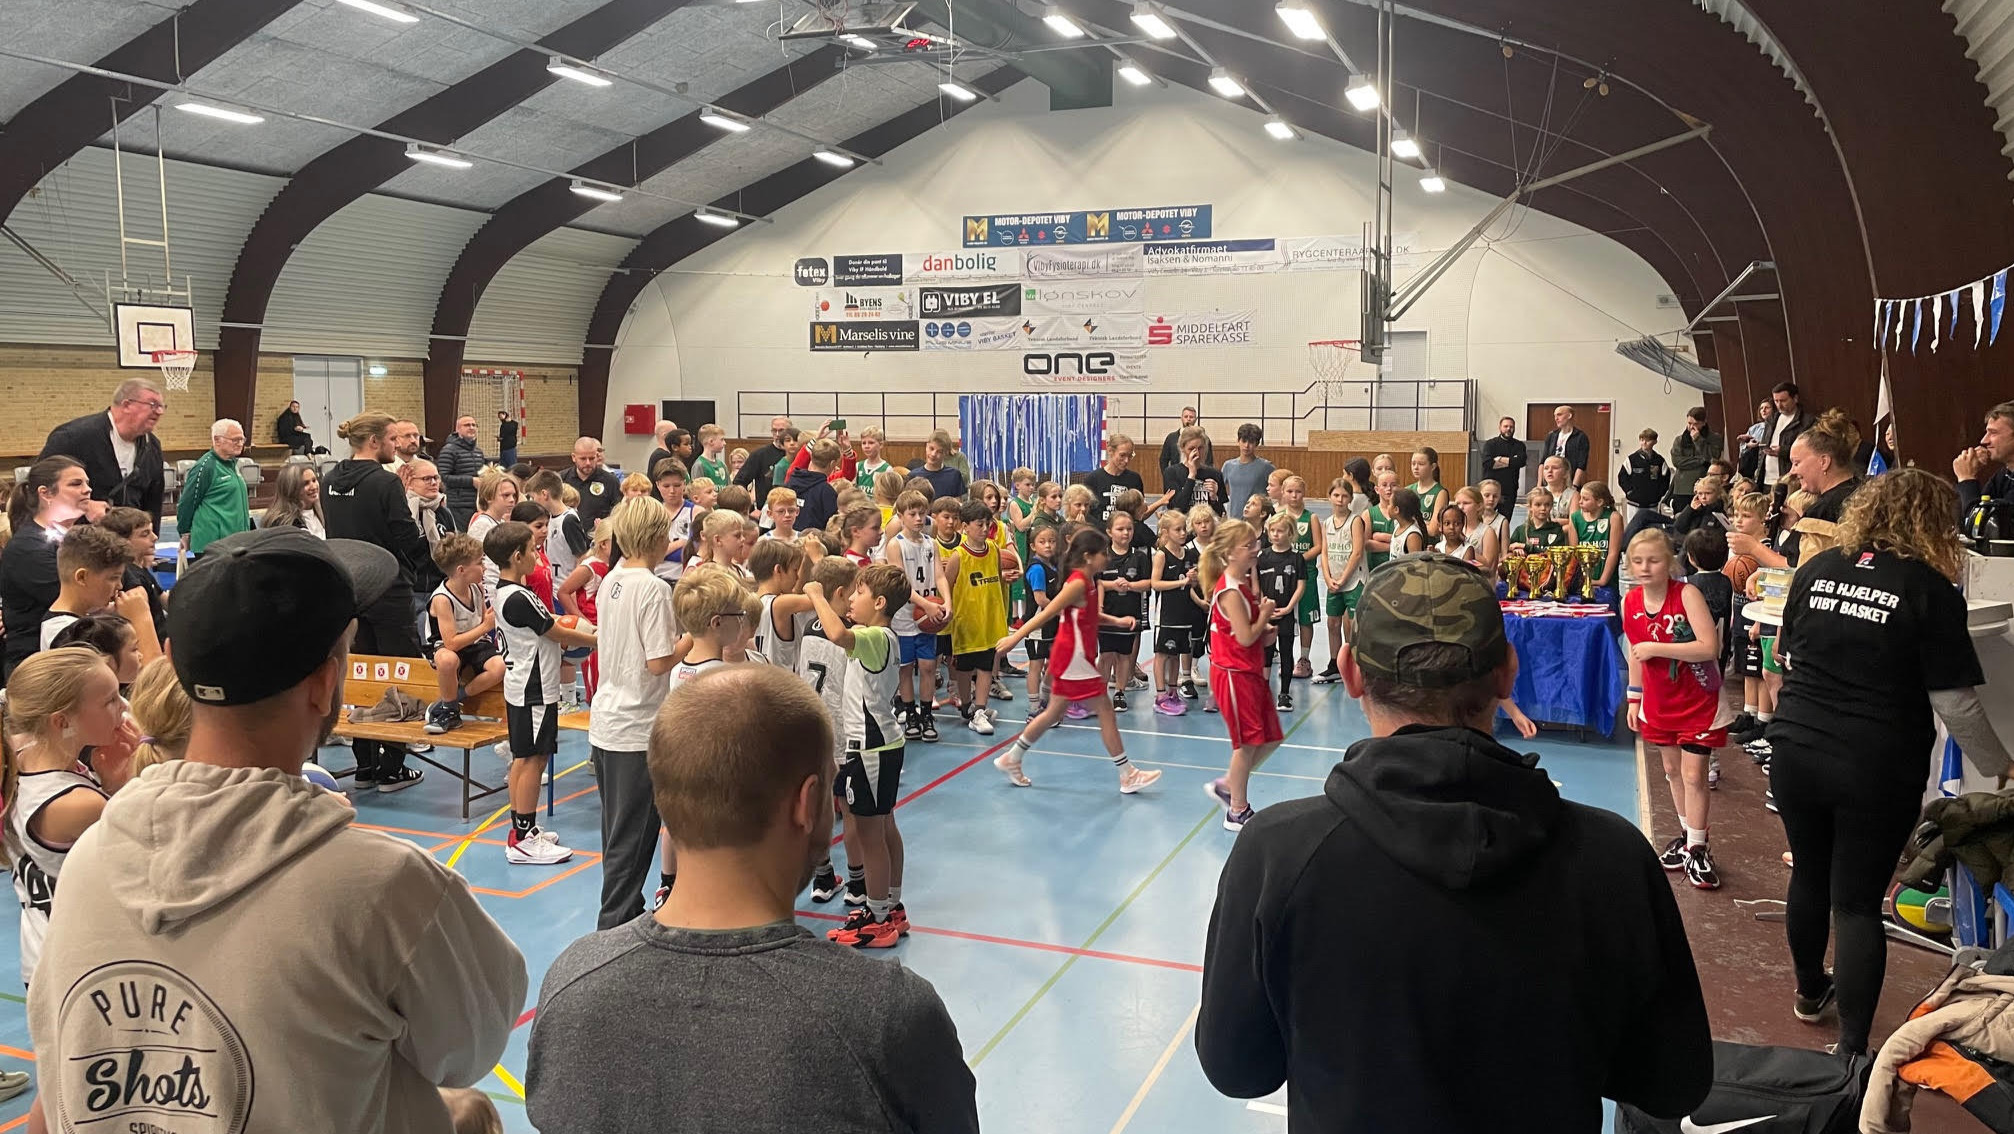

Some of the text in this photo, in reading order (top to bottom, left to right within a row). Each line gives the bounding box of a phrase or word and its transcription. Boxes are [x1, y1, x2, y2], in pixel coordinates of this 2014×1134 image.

[994, 214, 1071, 227] MOTOR-DEPOTET VIBY
[1116, 207, 1198, 221] MOTOR-DEPOTET VIBY
[1147, 244, 1228, 256] Advokatfirmaet
[923, 253, 997, 272] danbolig
[1147, 253, 1233, 265] Isaksen & Nomanni
[797, 265, 826, 278] føtex
[860, 298, 882, 307] BYENS
[943, 291, 1001, 306] VIBY EL
[840, 328, 915, 341] Marselis vine
[1176, 321, 1251, 334] MIDDELFART
[1176, 332, 1250, 345] SPAREKASSE
[1023, 351, 1115, 375] one
[916, 566, 925, 583] 4
[1274, 575, 1284, 594] 4
[1810, 578, 1900, 609] JEG HJÆLPER
[1308, 609, 1320, 622] 10
[1808, 595, 1891, 624] VIBY BASKET
[808, 661, 827, 694] 7
[90, 980, 193, 1035] PURE
[85, 1048, 211, 1113] Shots
